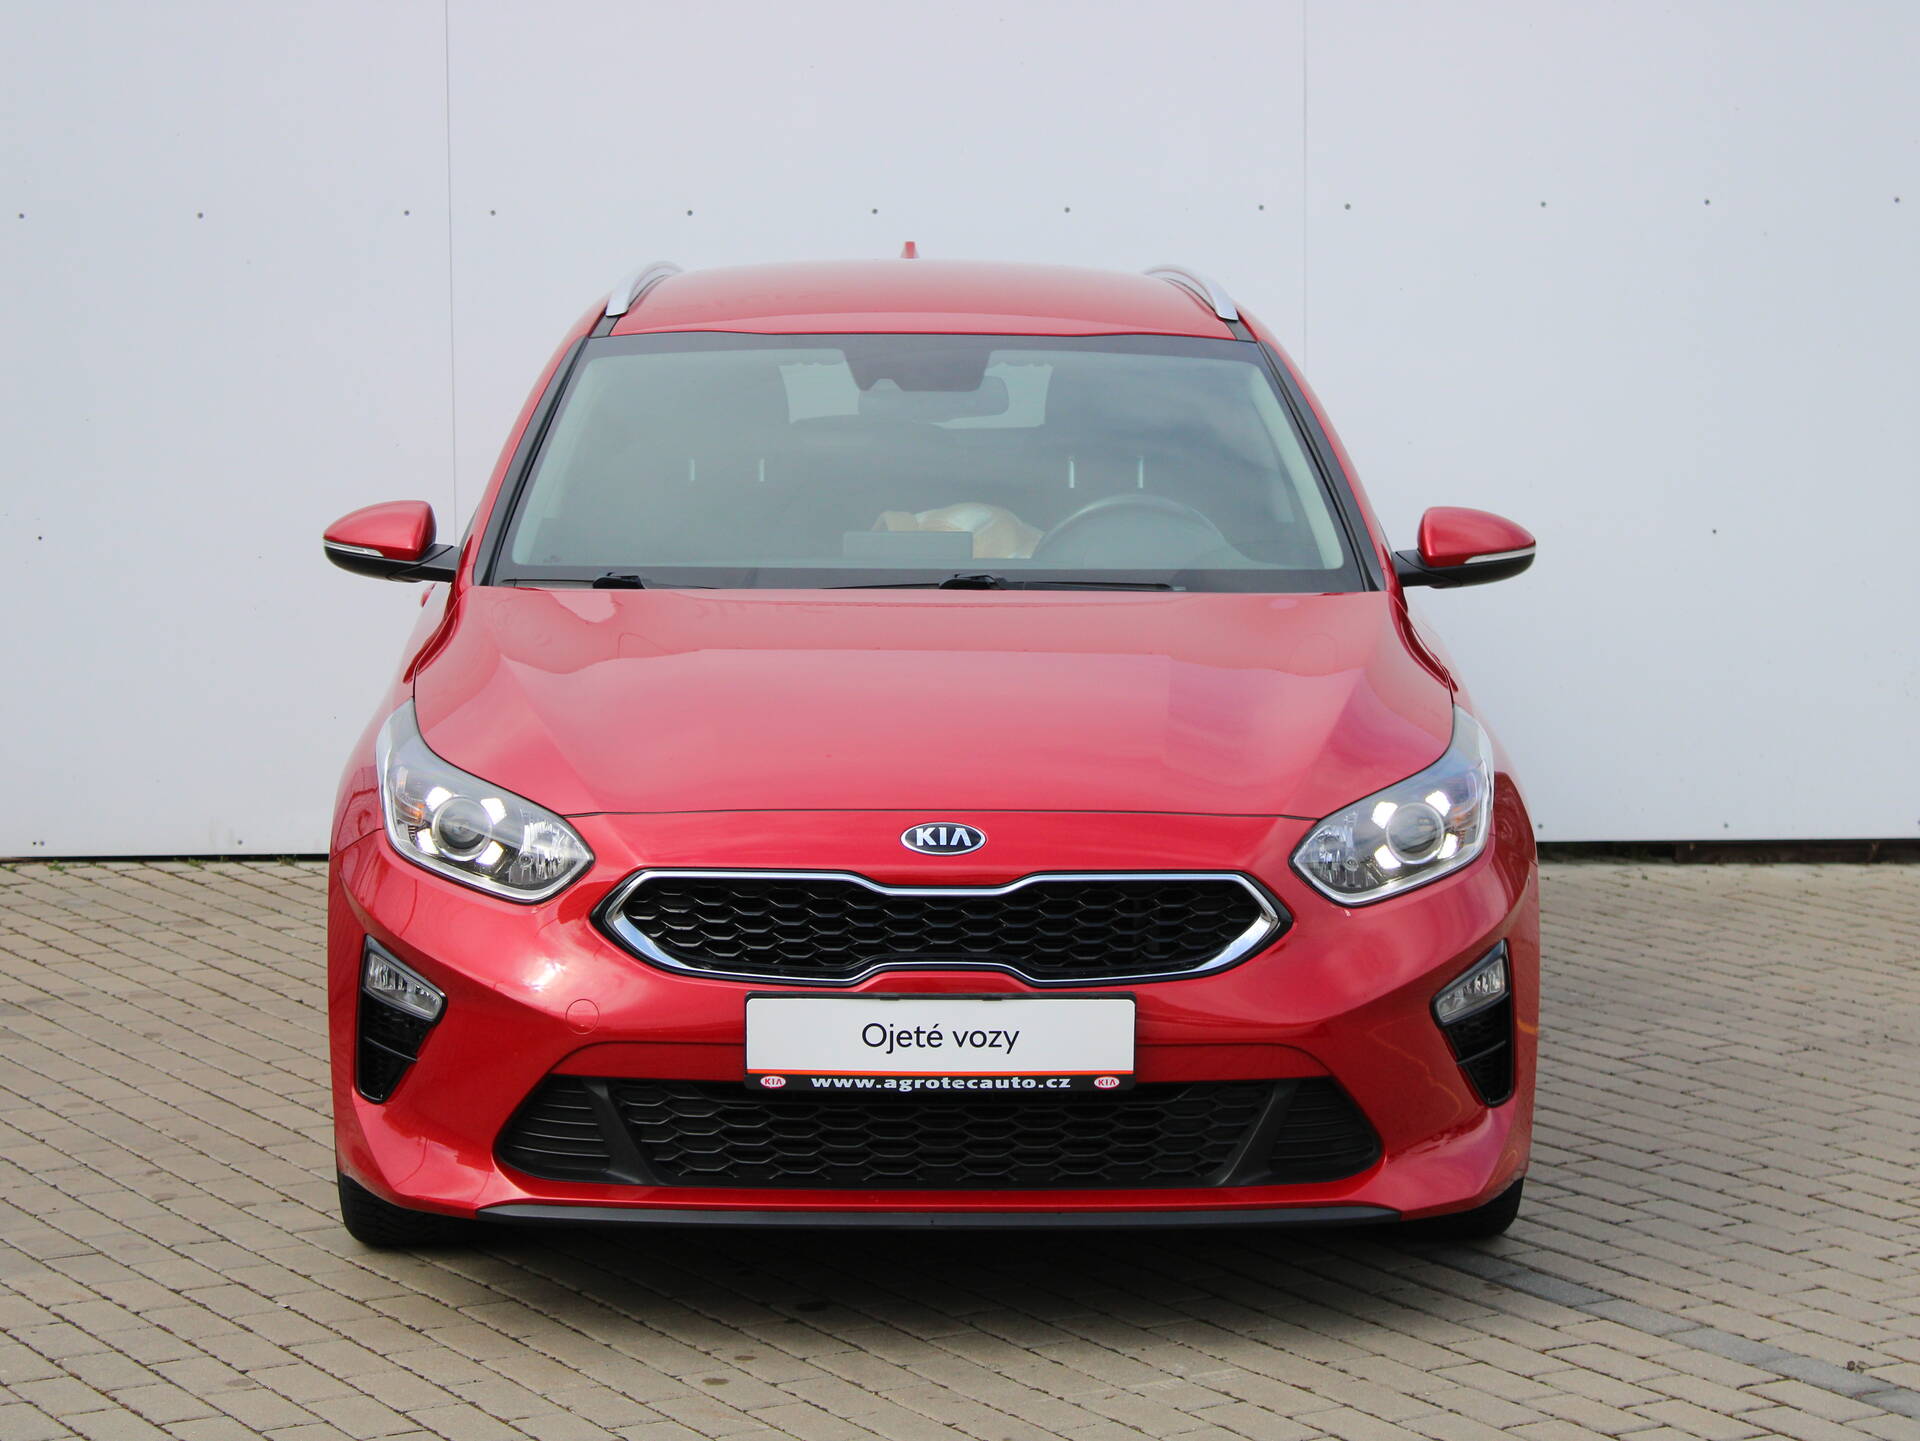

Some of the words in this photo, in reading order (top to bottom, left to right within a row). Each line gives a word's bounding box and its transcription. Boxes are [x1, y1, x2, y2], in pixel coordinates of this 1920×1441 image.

[915, 826, 972, 847] KIA
[862, 1022, 944, 1055] Ojeté
[952, 1030, 1020, 1055] vozy
[764, 1078, 783, 1086] KIA
[810, 1076, 1071, 1092] www.agrotecauto.cz
[1098, 1078, 1117, 1087] KIA
